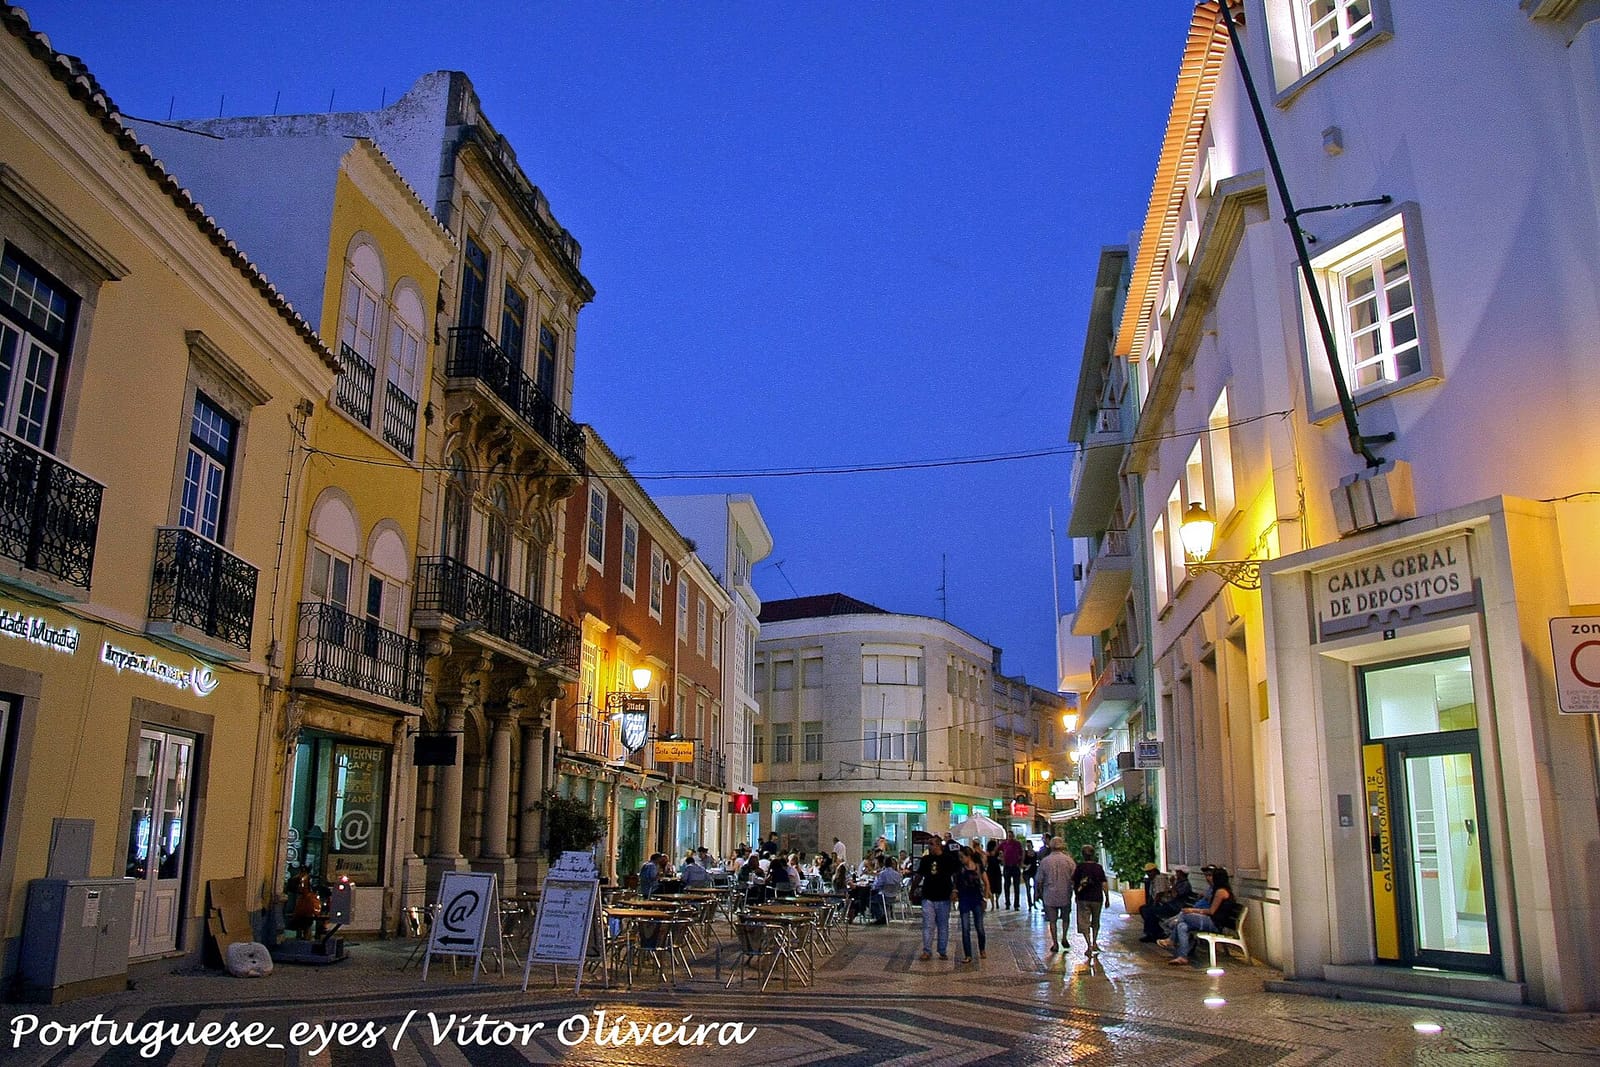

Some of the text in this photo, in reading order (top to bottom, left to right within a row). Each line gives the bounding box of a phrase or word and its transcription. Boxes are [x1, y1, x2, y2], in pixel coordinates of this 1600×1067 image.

[1327, 546, 1457, 594] CAIXA GERAL
[1329, 573, 1460, 618] DE DEPOSITOS
